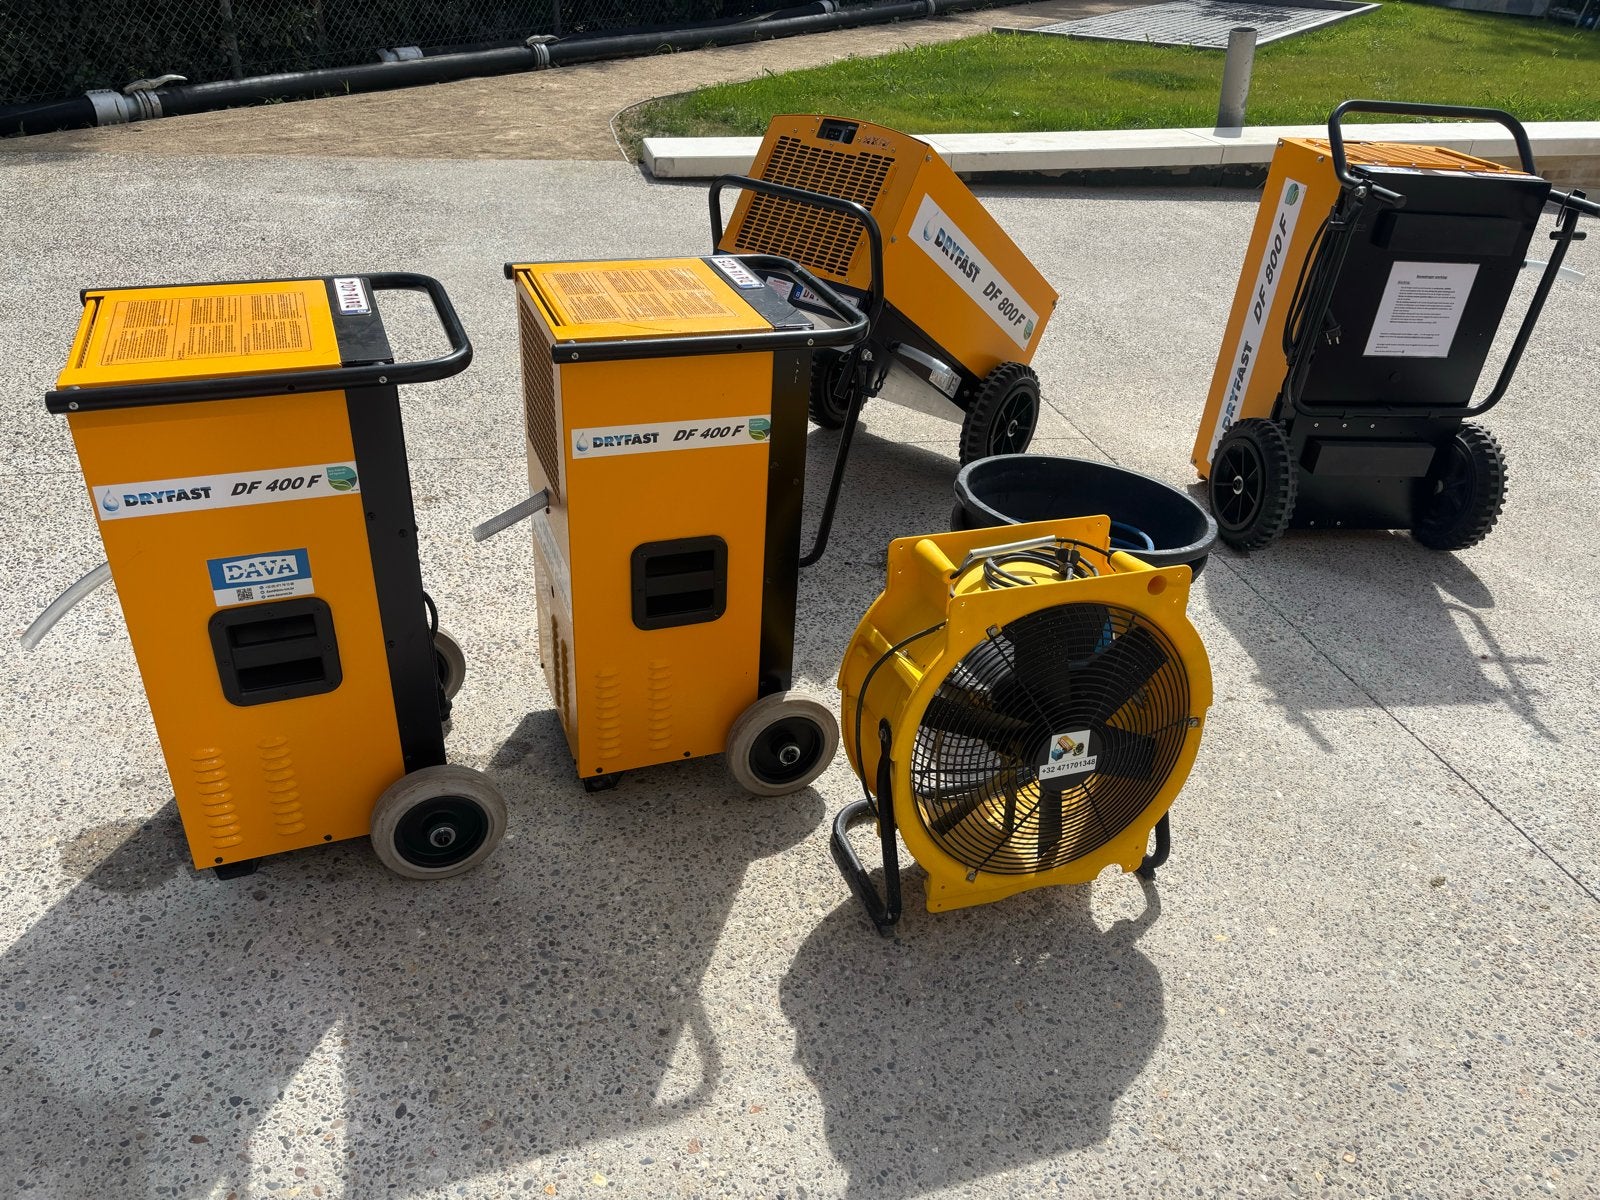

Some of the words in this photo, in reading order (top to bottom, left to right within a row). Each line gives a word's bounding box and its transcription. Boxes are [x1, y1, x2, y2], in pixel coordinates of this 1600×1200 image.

[934, 227, 981, 283] DRYFAST
[982, 280, 1002, 302] DF
[997, 297, 1020, 322] 800
[1013, 312, 1026, 326] F
[1221, 340, 1253, 432] DRYFAST
[1253, 284, 1266, 325] DF
[1265, 233, 1283, 285] 800
[1278, 212, 1287, 237] F
[592, 431, 660, 448] DRYFAST
[672, 428, 698, 442] DF
[700, 426, 731, 439] 400
[731, 424, 745, 437] F
[123, 485, 212, 507] DRYFAST
[230, 480, 262, 497] DF
[265, 476, 305, 492] 400
[306, 474, 322, 489] F
[225, 558, 295, 581] DAVA
[1042, 766, 1055, 774] +32
[1056, 759, 1095, 771] 471701348
